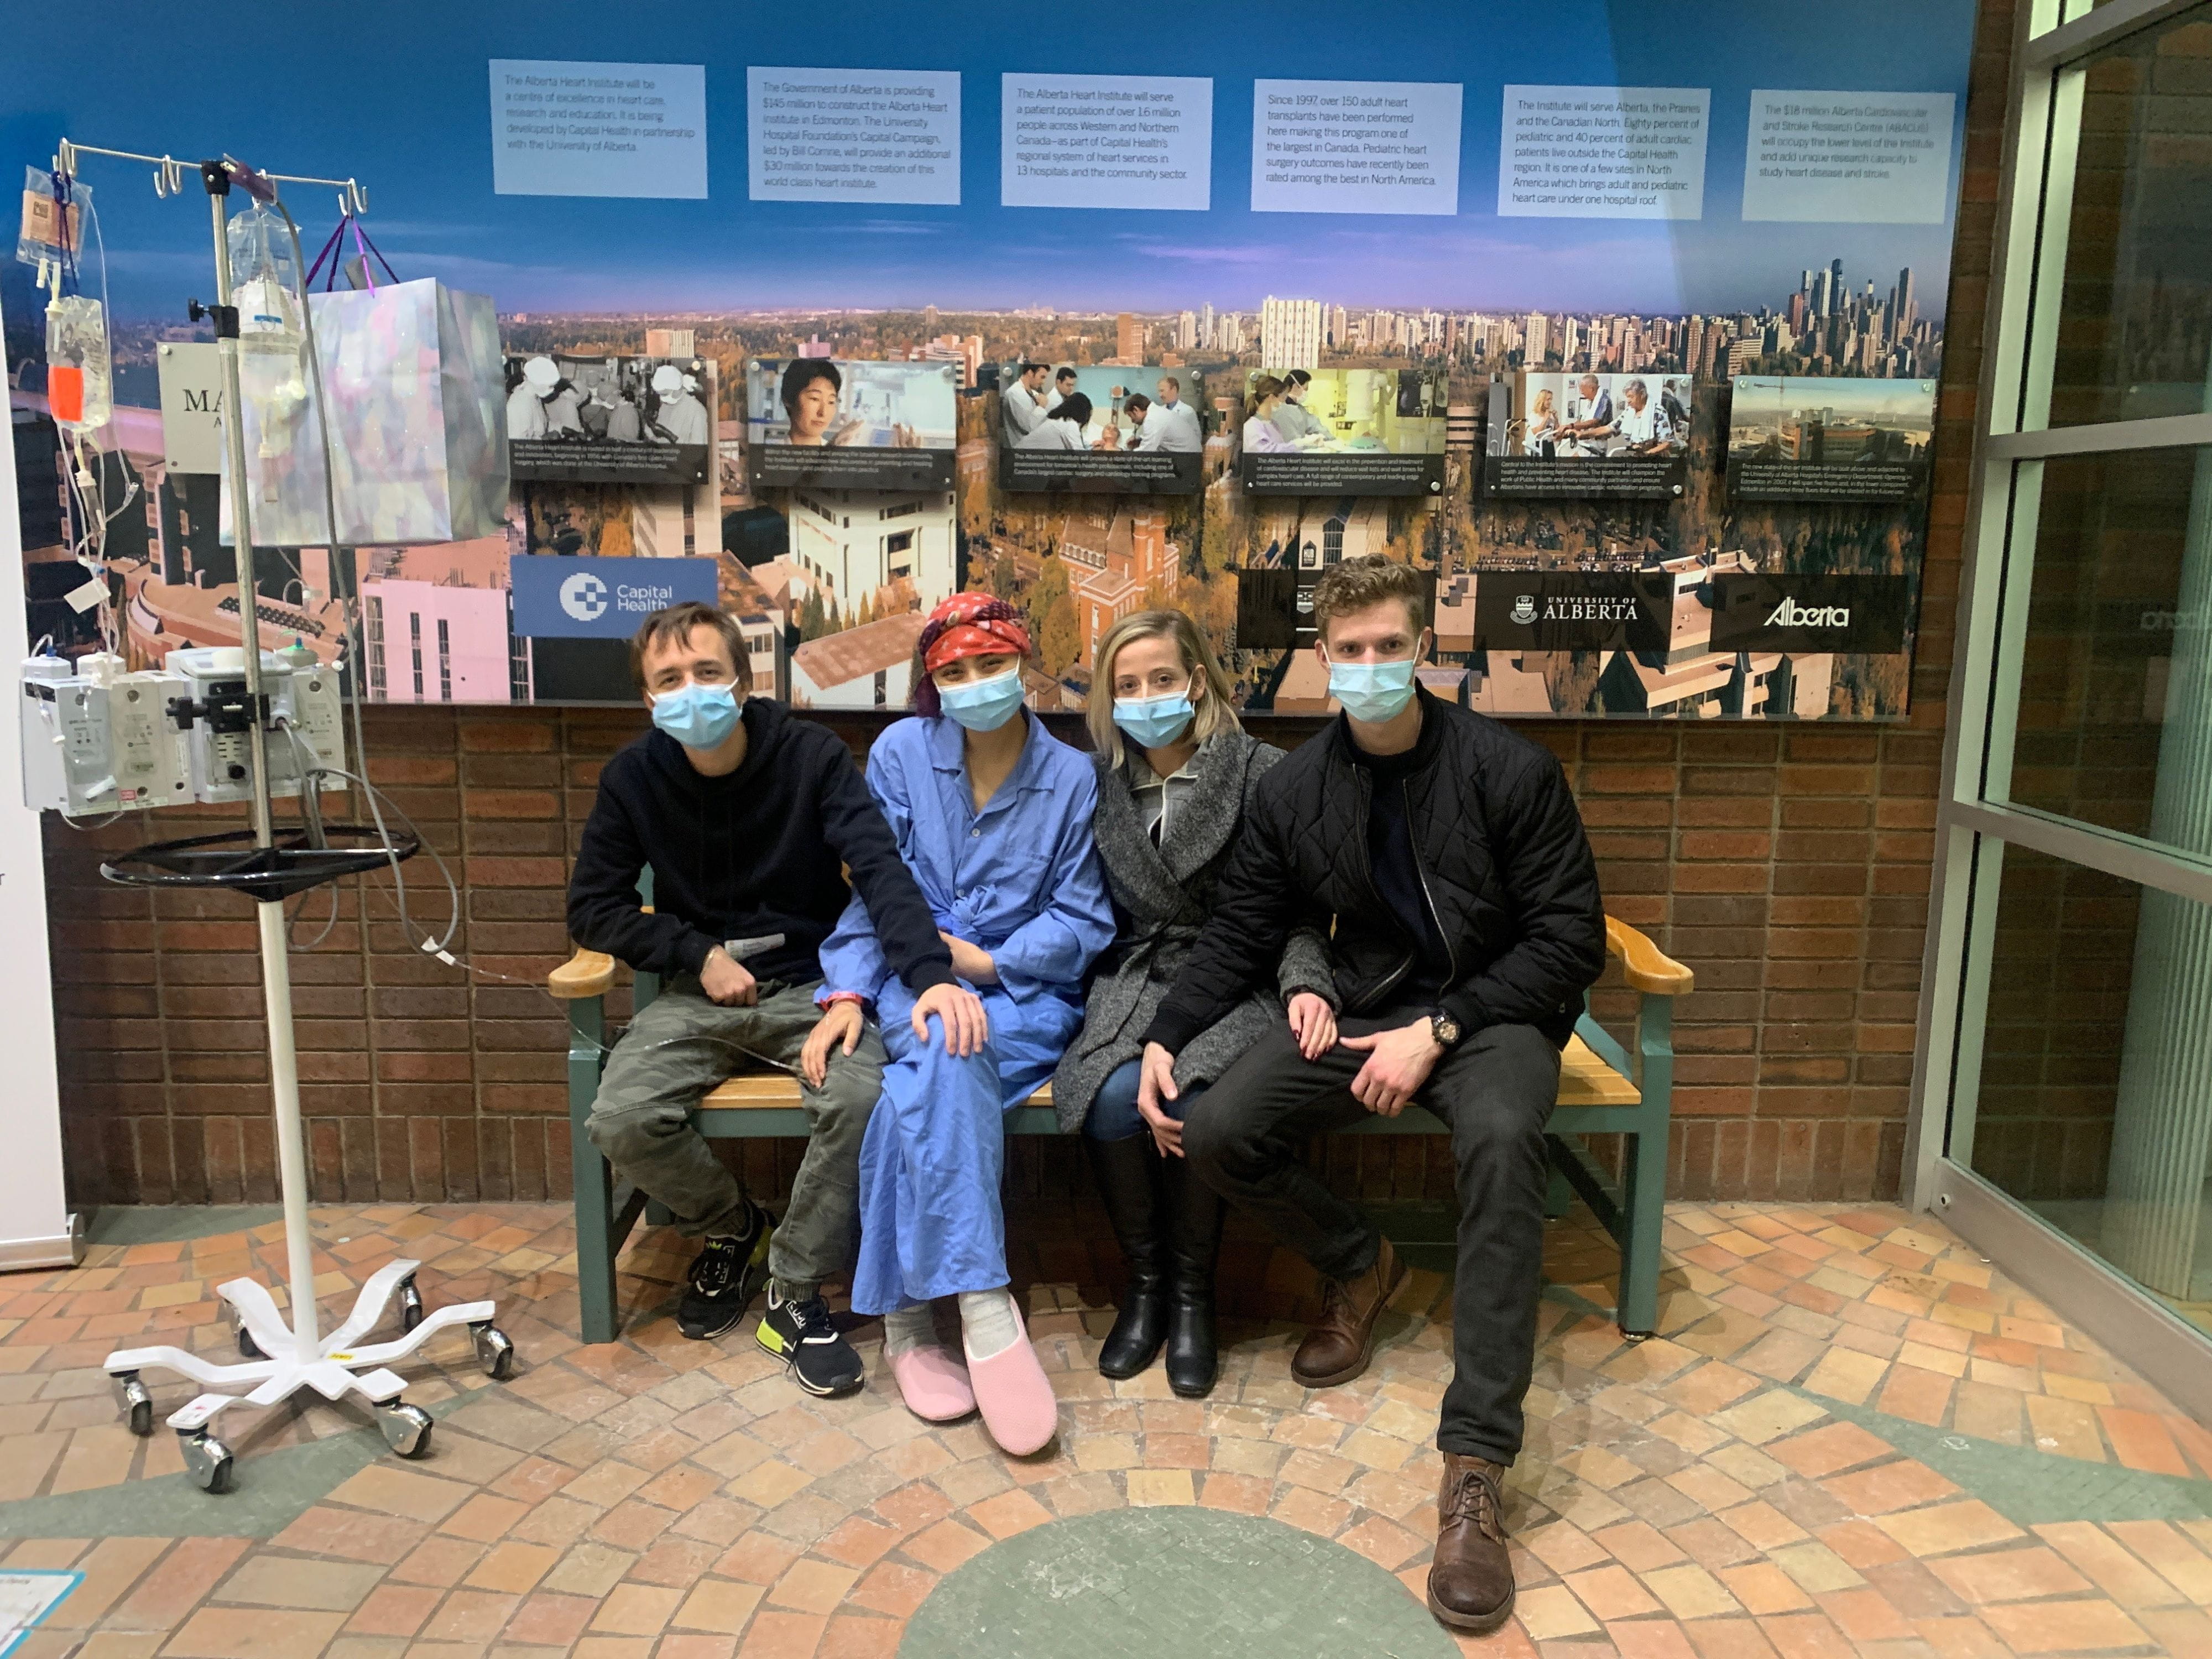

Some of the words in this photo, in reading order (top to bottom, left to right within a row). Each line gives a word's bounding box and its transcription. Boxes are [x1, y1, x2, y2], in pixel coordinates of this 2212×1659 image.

[1018, 88, 1034, 98] The
[1036, 89, 1068, 100] Alberta
[1070, 90, 1096, 100] Heart
[1097, 90, 1133, 101] Institute
[1134, 91, 1147, 101] will
[1149, 93, 1174, 102] serve
[1268, 95, 1292, 105] Since
[1342, 97, 1358, 106] 150
[1360, 97, 1383, 106] adult
[1385, 97, 1408, 107] heart
[1024, 105, 1055, 116] patient
[1057, 106, 1104, 117] population
[1106, 107, 1115, 116] of
[1152, 107, 1181, 117] million
[1519, 100, 1534, 109] The
[1537, 101, 1572, 111] Institute
[1574, 101, 1588, 111] will
[1653, 103, 1667, 112] the
[1267, 111, 1317, 122] transplants
[1319, 112, 1340, 121] have
[1342, 112, 1365, 122] been
[1367, 113, 1414, 124] performed
[1516, 116, 1533, 126] and
[1536, 117, 1549, 126] the
[1551, 117, 1593, 127] Canadian
[1625, 118, 1651, 129] Eighty
[1691, 119, 1699, 129] of
[1017, 120, 1047, 131] people
[1081, 121, 1117, 131] Western
[1119, 122, 1136, 132] and
[1139, 122, 1179, 133] Northern
[1267, 126, 1287, 136] here
[1290, 127, 1322, 138] making
[1324, 127, 1340, 137] this
[1342, 130, 1379, 139] program
[1400, 129, 1408, 138] of
[1070, 137, 1088, 148] part
[1090, 137, 1099, 147] of
[1100, 137, 1131, 149] Capital
[1516, 132, 1553, 143] pediatric
[1556, 132, 1573, 142] and
[1575, 133, 1587, 142] 40
[1625, 134, 1634, 143] of
[1636, 134, 1658, 144] adult
[1660, 134, 1692, 144] cardiac
[1267, 142, 1281, 152] the
[1284, 143, 1312, 154] largest
[1314, 143, 1322, 153] in
[1324, 143, 1360, 153] Canada.
[1364, 144, 1401, 154] Pediatric
[1404, 145, 1427, 155] heart
[1515, 147, 1550, 159] patients
[1552, 148, 1566, 158] live
[1568, 148, 1600, 158] outside
[1601, 149, 1615, 158] the
[1618, 149, 1647, 160] Capital
[1650, 150, 1678, 160] Health
[1016, 151, 1051, 162] regional
[1053, 152, 1084, 163] system
[1086, 153, 1095, 161] of
[1097, 153, 1120, 162] heart
[1123, 153, 1158, 163] services
[1161, 154, 1168, 163] in
[1266, 160, 1298, 169] surgery
[1301, 159, 1344, 169] outcomes
[1347, 159, 1367, 169] have
[1369, 160, 1404, 171] recently
[1406, 161, 1429, 170] been
[1545, 163, 1551, 173] It
[1552, 164, 1559, 173] is
[1580, 164, 1589, 174] of
[1598, 164, 1613, 174] few
[1615, 165, 1634, 174] sites
[1636, 165, 1644, 175] in
[1646, 165, 1672, 175] North
[1017, 166, 1027, 175] 13
[1030, 166, 1068, 178] hospitals
[1071, 168, 1089, 177] and
[1091, 168, 1105, 177] the
[1107, 168, 1157, 180] community
[1266, 173, 1288, 182] rated
[1290, 175, 1321, 185] among
[1324, 174, 1338, 184] the
[1340, 174, 1359, 184] best
[1361, 175, 1369, 184] in
[1371, 175, 1396, 185] North
[1399, 176, 1436, 185] America.
[1513, 178, 1549, 188] America
[1551, 179, 1577, 189] which
[1579, 179, 1606, 191] brings
[1608, 180, 1630, 190] adult
[1631, 180, 1648, 190] and
[1651, 181, 1688, 192] pediatric
[1512, 193, 1535, 202] heart
[1558, 194, 1583, 204] under
[1604, 195, 1637, 206] hospital
[617, 584, 672, 599] Capital
[618, 598, 667, 611] Health
[1542, 604, 1638, 619] ALBERTA
[1764, 596, 1850, 627] Alberta
